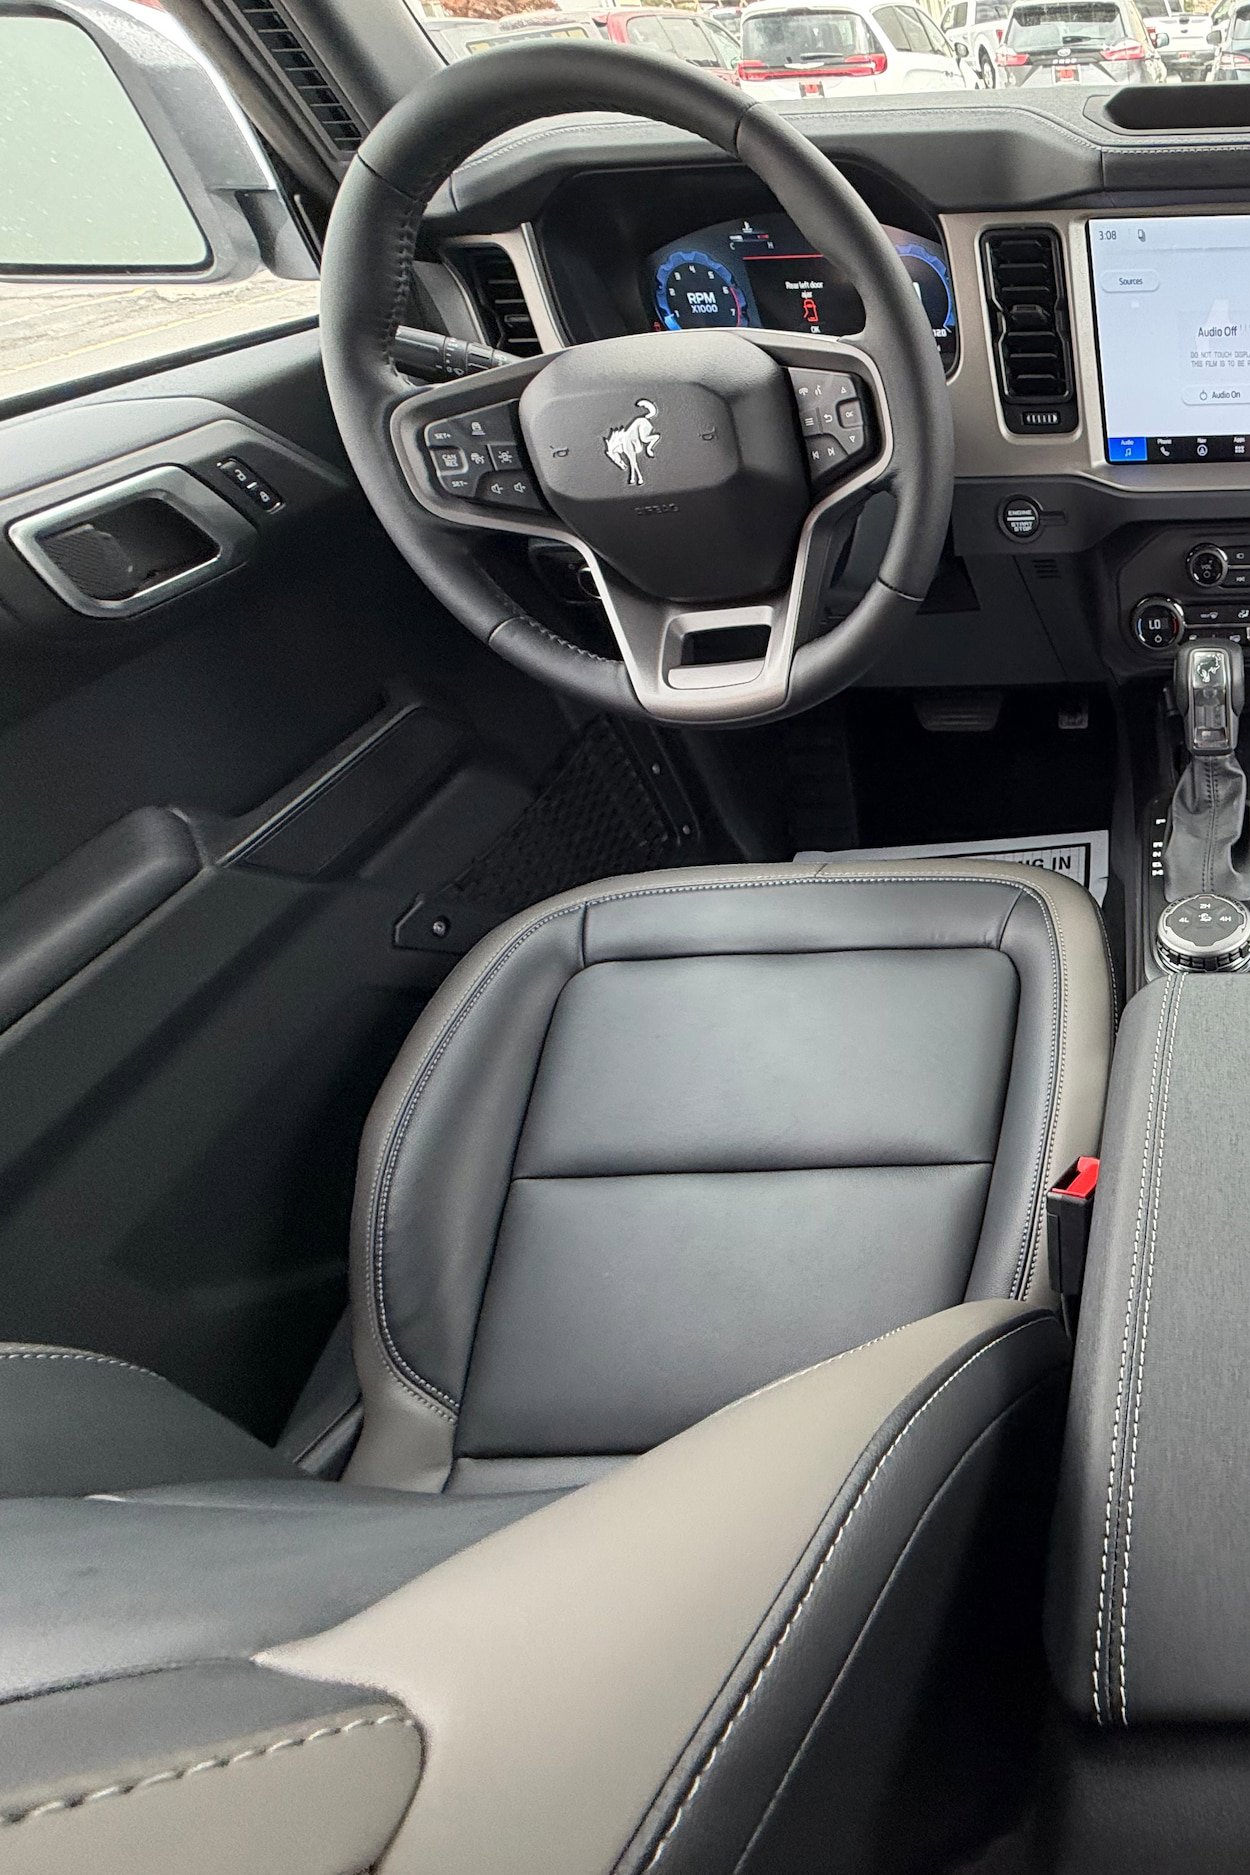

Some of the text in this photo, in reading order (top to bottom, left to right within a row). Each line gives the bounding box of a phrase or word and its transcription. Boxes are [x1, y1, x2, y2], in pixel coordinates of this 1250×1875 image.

[1099, 230, 1117, 241] 3:08
[767, 241, 774, 249] H
[688, 265, 696, 273] 4
[674, 272, 681, 280] 3
[708, 271, 715, 279] 5
[785, 281, 824, 289] Rear left door
[1118, 277, 1143, 286] Sources
[668, 287, 676, 296] 2
[722, 286, 729, 294] 6
[687, 292, 716, 304] RPM
[691, 304, 718, 314] X1000
[730, 308, 736, 316] 7
[675, 310, 680, 318] 1
[1198, 326, 1238, 337] Audio Off
[1211, 391, 1230, 399] Audio
[845, 410, 854, 418] OK
[1052, 855, 1071, 870] IN
